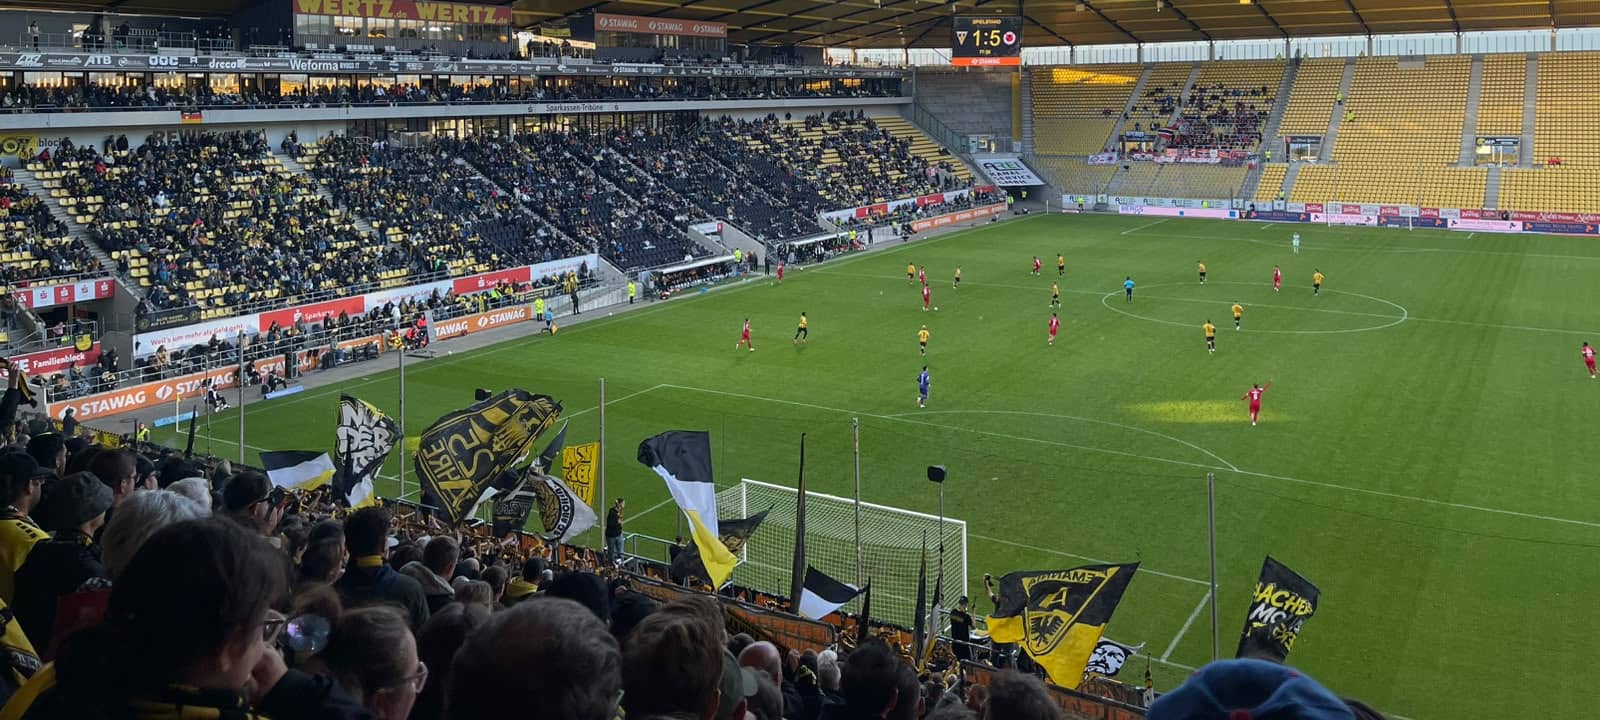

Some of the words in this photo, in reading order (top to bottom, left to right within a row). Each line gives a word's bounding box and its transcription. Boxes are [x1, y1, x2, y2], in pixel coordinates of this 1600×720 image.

[608, 19, 638, 29] STAWAG
[657, 22, 683, 31] STAWAG
[700, 25, 725, 34] STAWAG
[84, 55, 112, 67] ATB
[289, 59, 339, 71] Weforma
[546, 103, 603, 113] Sparkassen-Tribüne
[489, 308, 525, 325] STAWAG
[434, 321, 468, 337] TAWAG
[33, 352, 85, 369] Familienblock
[81, 391, 146, 416] STAWAG
